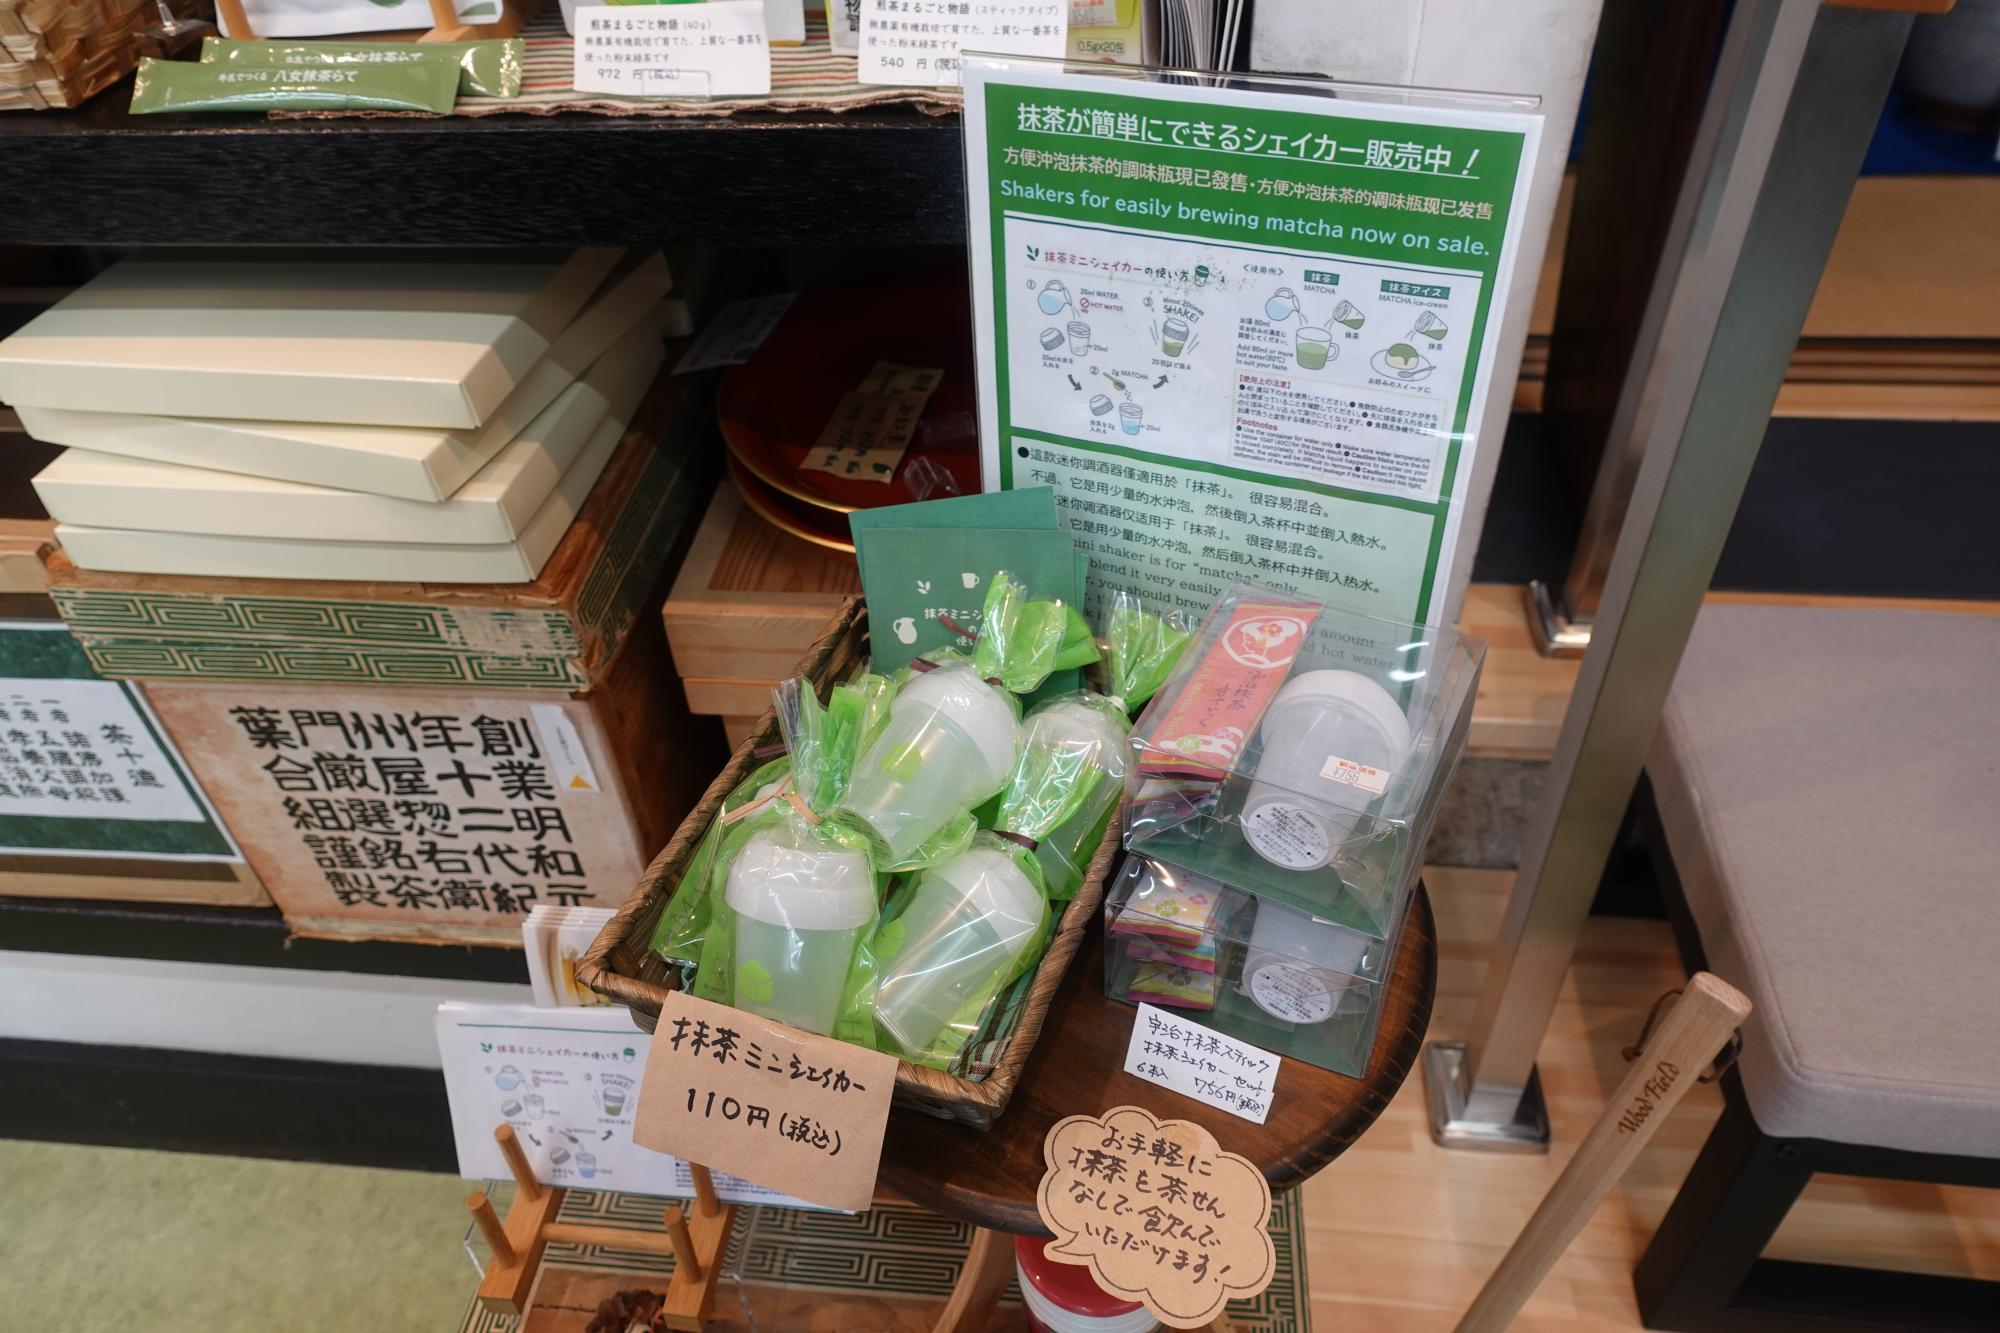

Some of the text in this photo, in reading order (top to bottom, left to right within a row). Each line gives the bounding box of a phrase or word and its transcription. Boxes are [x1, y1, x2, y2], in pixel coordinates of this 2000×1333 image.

[880, 57, 904, 67] 540
[597, 69, 621, 79] 972
[1017, 102, 1480, 176] 抹茶が簡単にできるシェイカー販売中！
[1000, 179, 1490, 255] Shakers for easily brewing matcha now on sale.
[1044, 250, 1190, 283] 抹茶ミニシェイカーの使い方
[1310, 272, 1332, 284] 抹茶
[1303, 284, 1336, 295] MATCHA
[1388, 283, 1442, 298] 抹茶アイス
[1378, 294, 1412, 305] MATCHA
[1163, 305, 1201, 324] SHAKE!
[1277, 350, 1294, 358] more
[1121, 370, 1149, 381] MATCHA
[1236, 416, 1278, 431] Footnotes
[1098, 541, 1146, 562] shaker
[1150, 553, 1161, 566] is
[1165, 557, 1186, 571] for
[1090, 557, 1222, 597] blend it very easily
[1099, 579, 1123, 593] you
[1126, 584, 1171, 604] should
[1175, 596, 1211, 611] brew
[1320, 628, 1376, 649] amount
[1320, 643, 1345, 660] hot
[670, 1017, 866, 1093] 抹茶ミニシェイカー
[1137, 1062, 1169, 1080] 6本入
[1101, 1126, 1212, 1177] お手軽に
[1068, 1180, 1221, 1247] なしで飲んで
